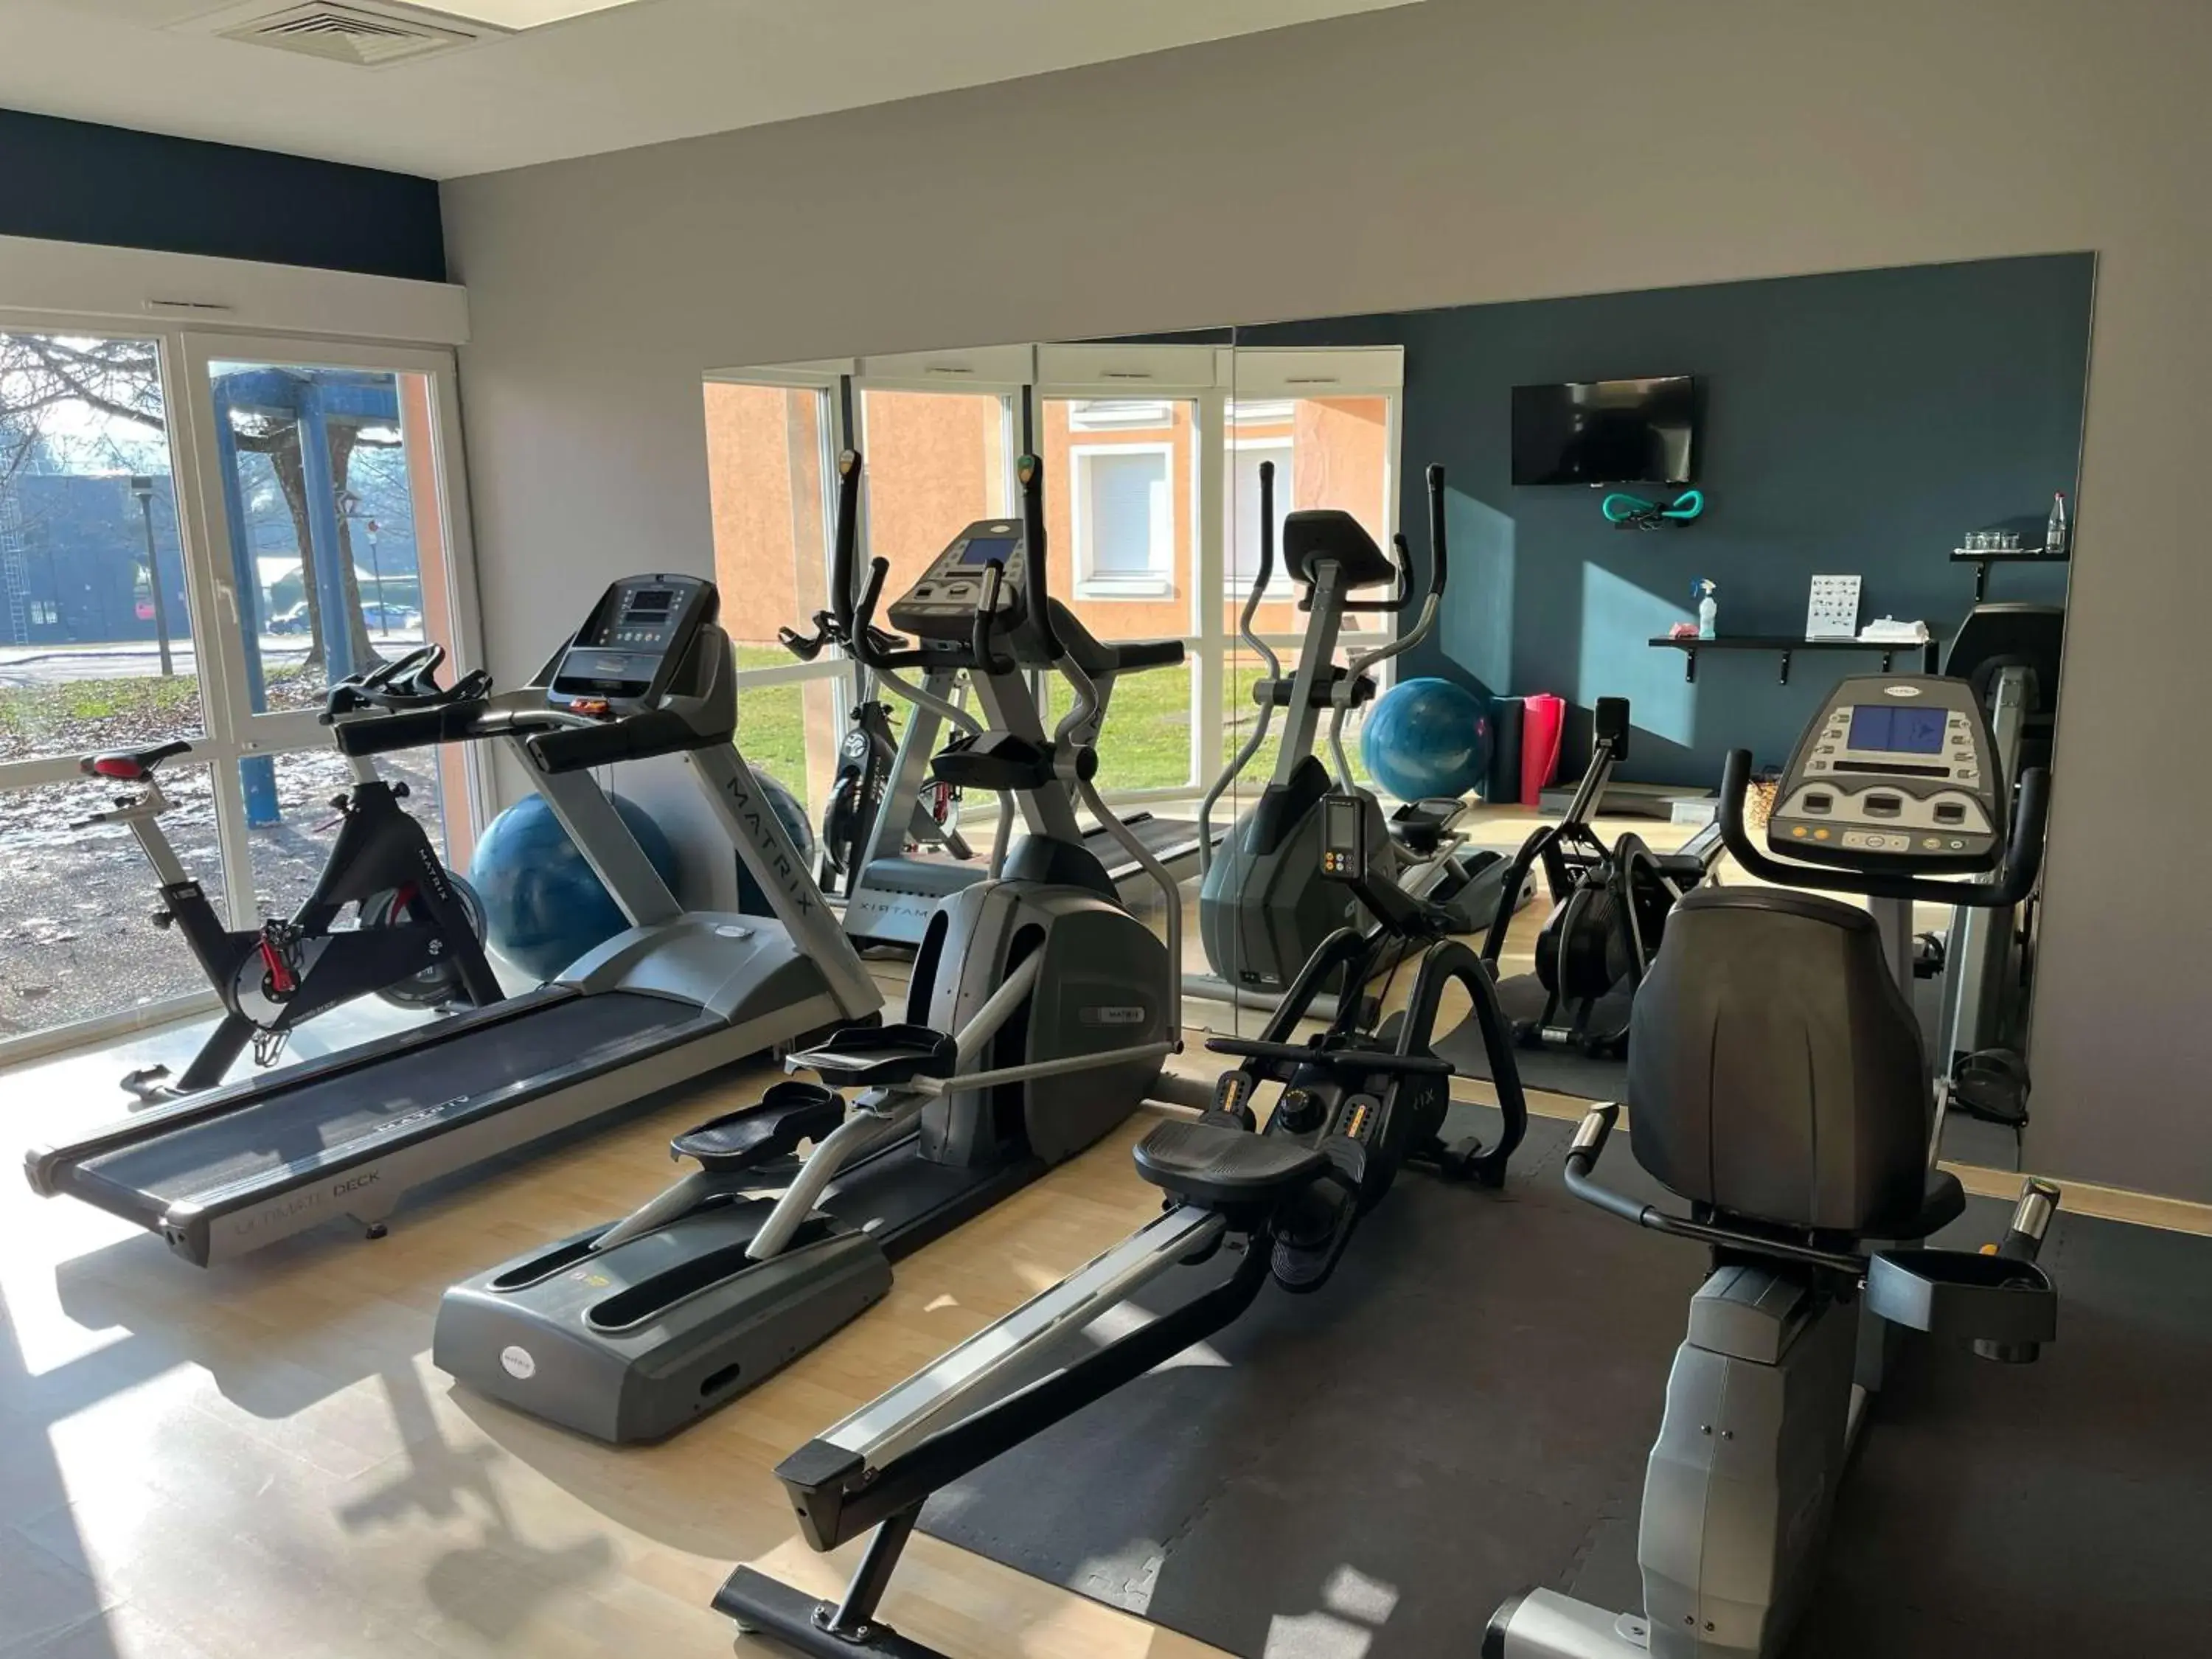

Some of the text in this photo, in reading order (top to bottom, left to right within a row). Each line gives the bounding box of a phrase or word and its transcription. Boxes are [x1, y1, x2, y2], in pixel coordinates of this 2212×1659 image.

[727, 776, 815, 915] MATRIX
[419, 849, 448, 900] MATRIX
[333, 1169, 380, 1197] DECK
